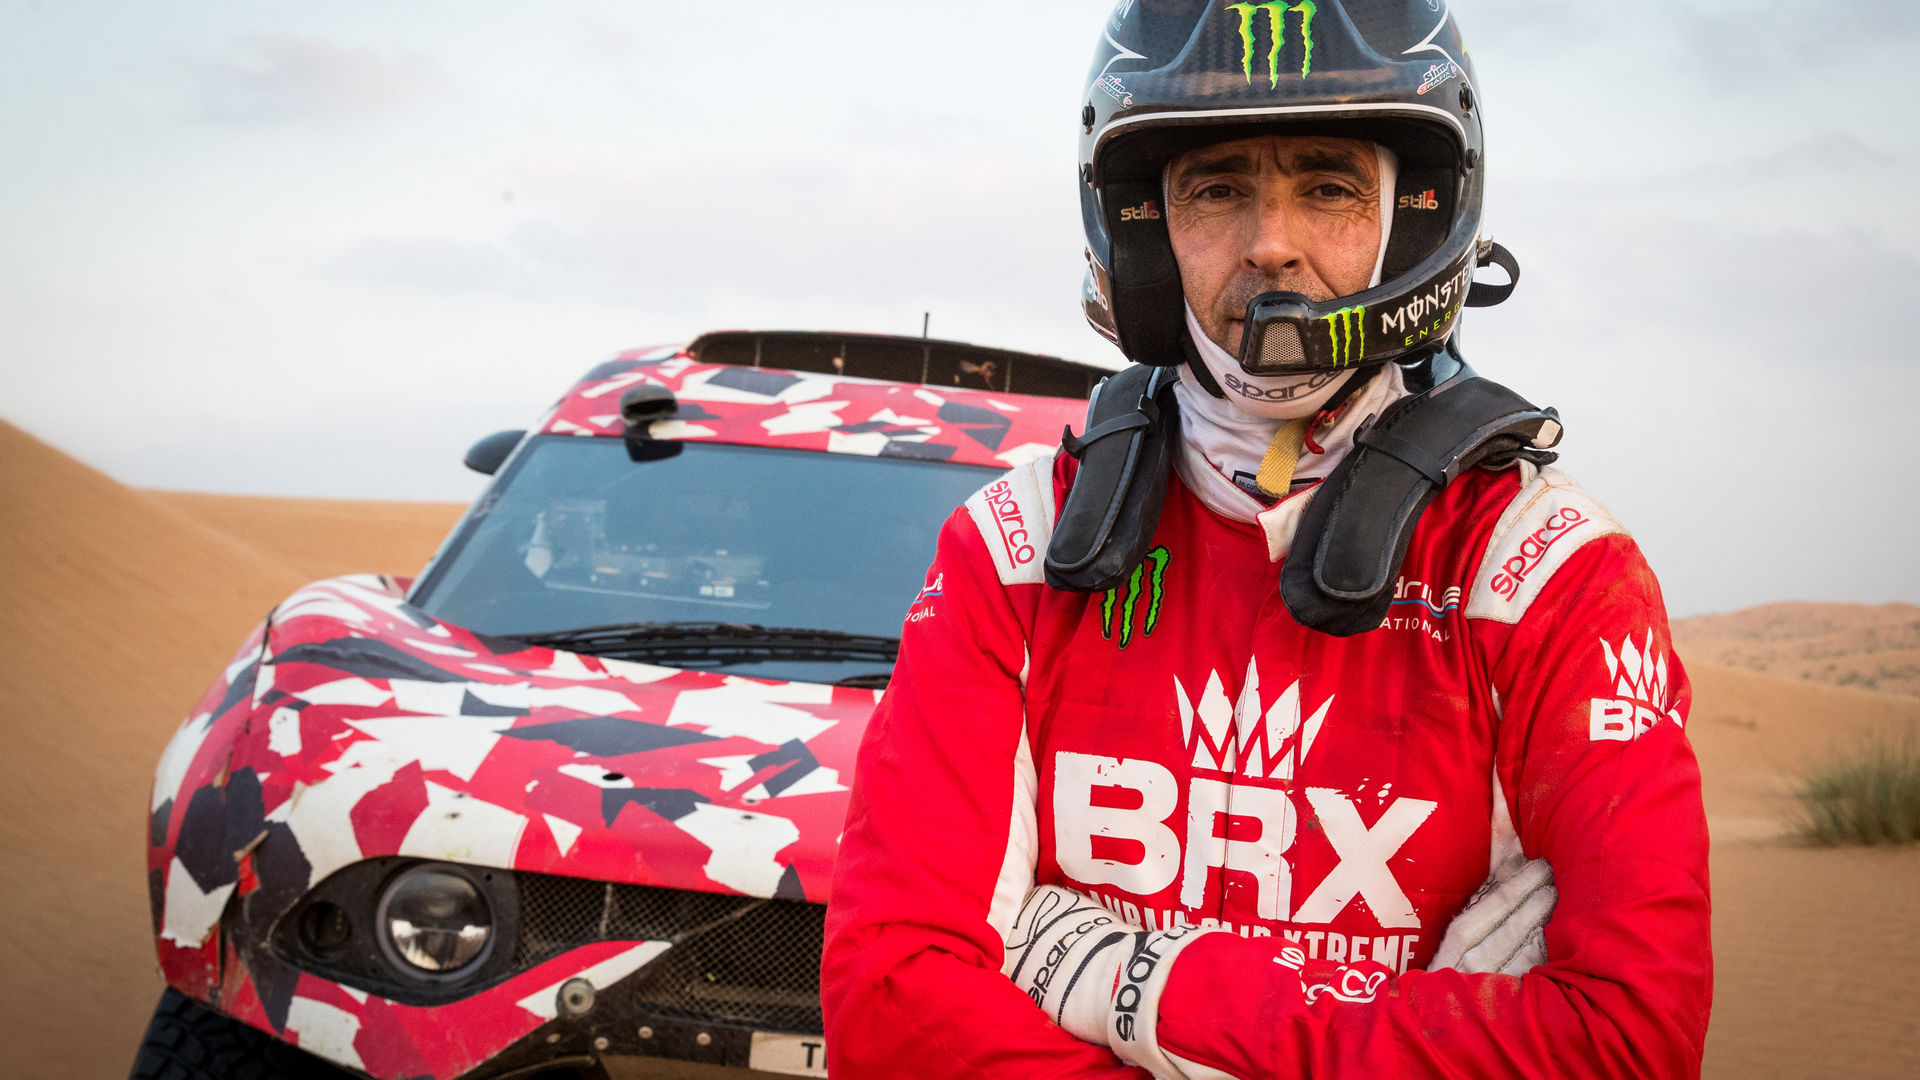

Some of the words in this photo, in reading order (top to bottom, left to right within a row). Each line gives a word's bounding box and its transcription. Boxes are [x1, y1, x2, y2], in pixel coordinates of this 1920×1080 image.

[1404, 300, 1461, 347] ENERG
[984, 480, 1036, 565] sparco
[1490, 506, 1584, 597] sparco
[1380, 616, 1450, 642] ATIONAL
[1053, 750, 1438, 929] BRX
[801, 1042, 828, 1070] T
